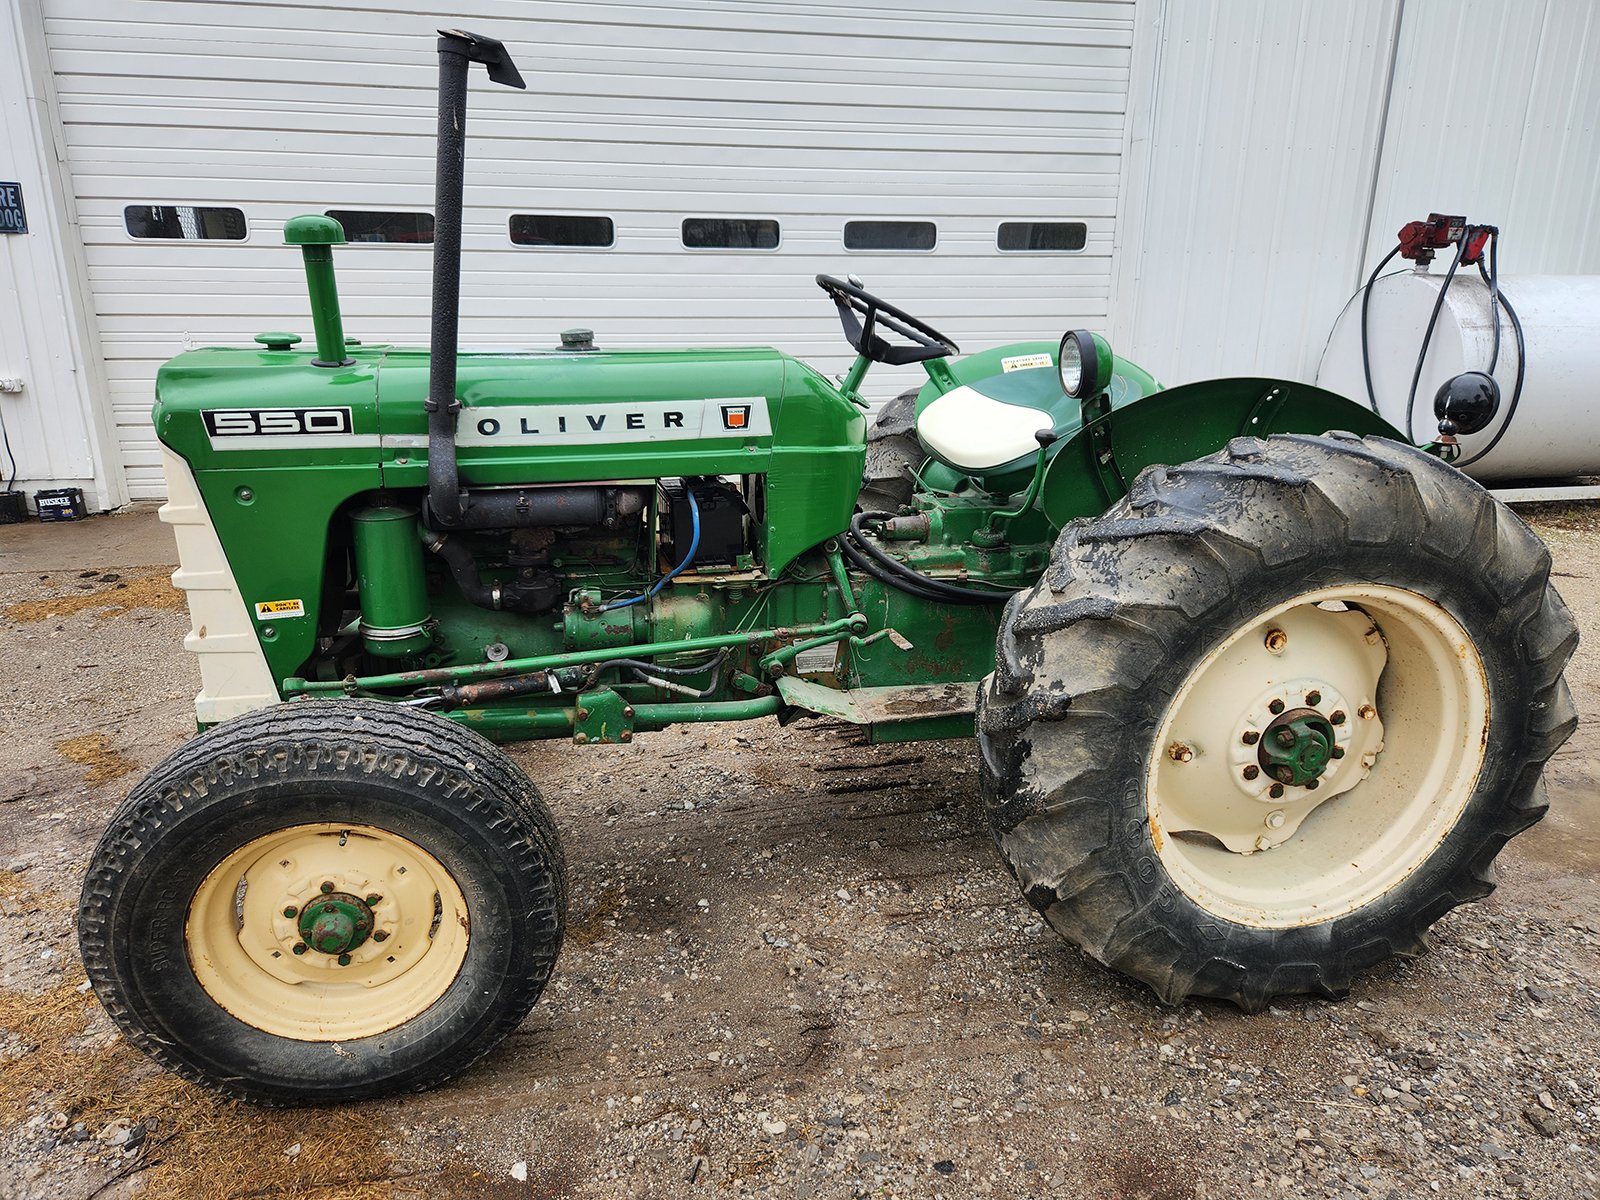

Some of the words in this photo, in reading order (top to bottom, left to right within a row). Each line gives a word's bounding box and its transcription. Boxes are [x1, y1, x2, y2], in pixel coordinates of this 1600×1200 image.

[213, 411, 344, 434] 550
[476, 411, 684, 436] OLIVER
[39, 497, 70, 506] HUSKEE
